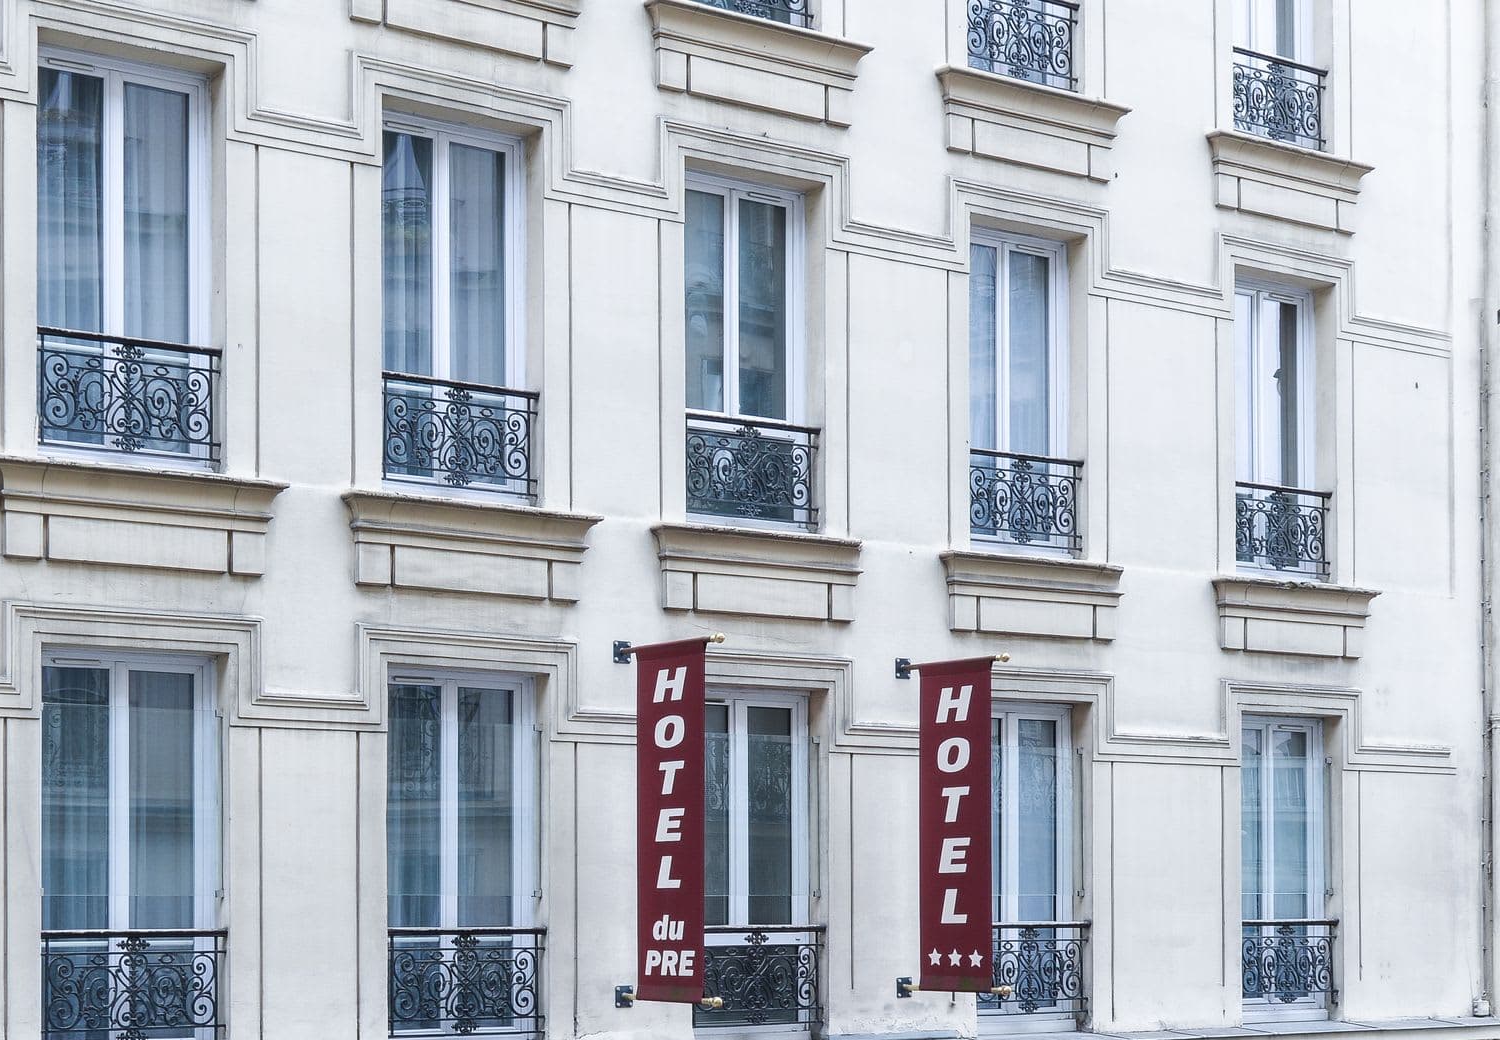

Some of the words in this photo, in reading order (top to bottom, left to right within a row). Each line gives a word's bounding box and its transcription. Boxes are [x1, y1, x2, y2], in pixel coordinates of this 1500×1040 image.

[652, 666, 687, 889] HOTEL
[935, 684, 974, 924] HOTEL
[644, 950, 696, 977] PRE
[652, 914, 685, 941] du
